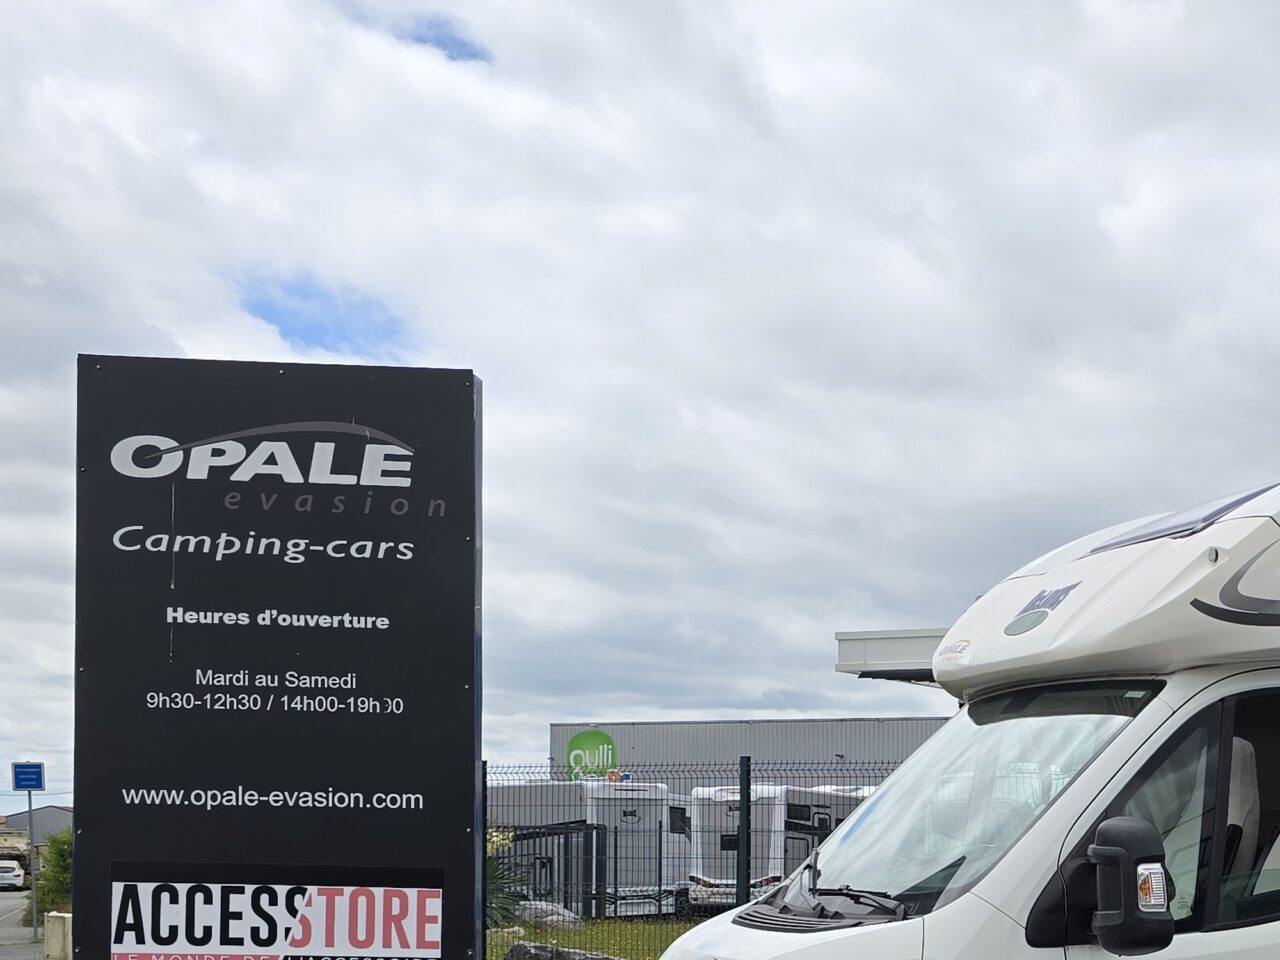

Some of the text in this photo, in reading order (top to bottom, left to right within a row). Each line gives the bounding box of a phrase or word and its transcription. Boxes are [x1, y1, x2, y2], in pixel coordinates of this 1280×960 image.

[110, 434, 414, 487] OPALE
[223, 489, 447, 517] evasion
[113, 526, 413, 563] Camping-cars
[167, 607, 250, 624] Heures
[196, 669, 355, 688] Mardi au Samedi
[147, 693, 261, 710] 9h30-12h30
[122, 786, 423, 810] www.opale-evasion.com
[112, 883, 441, 950] ACCESSTORE
